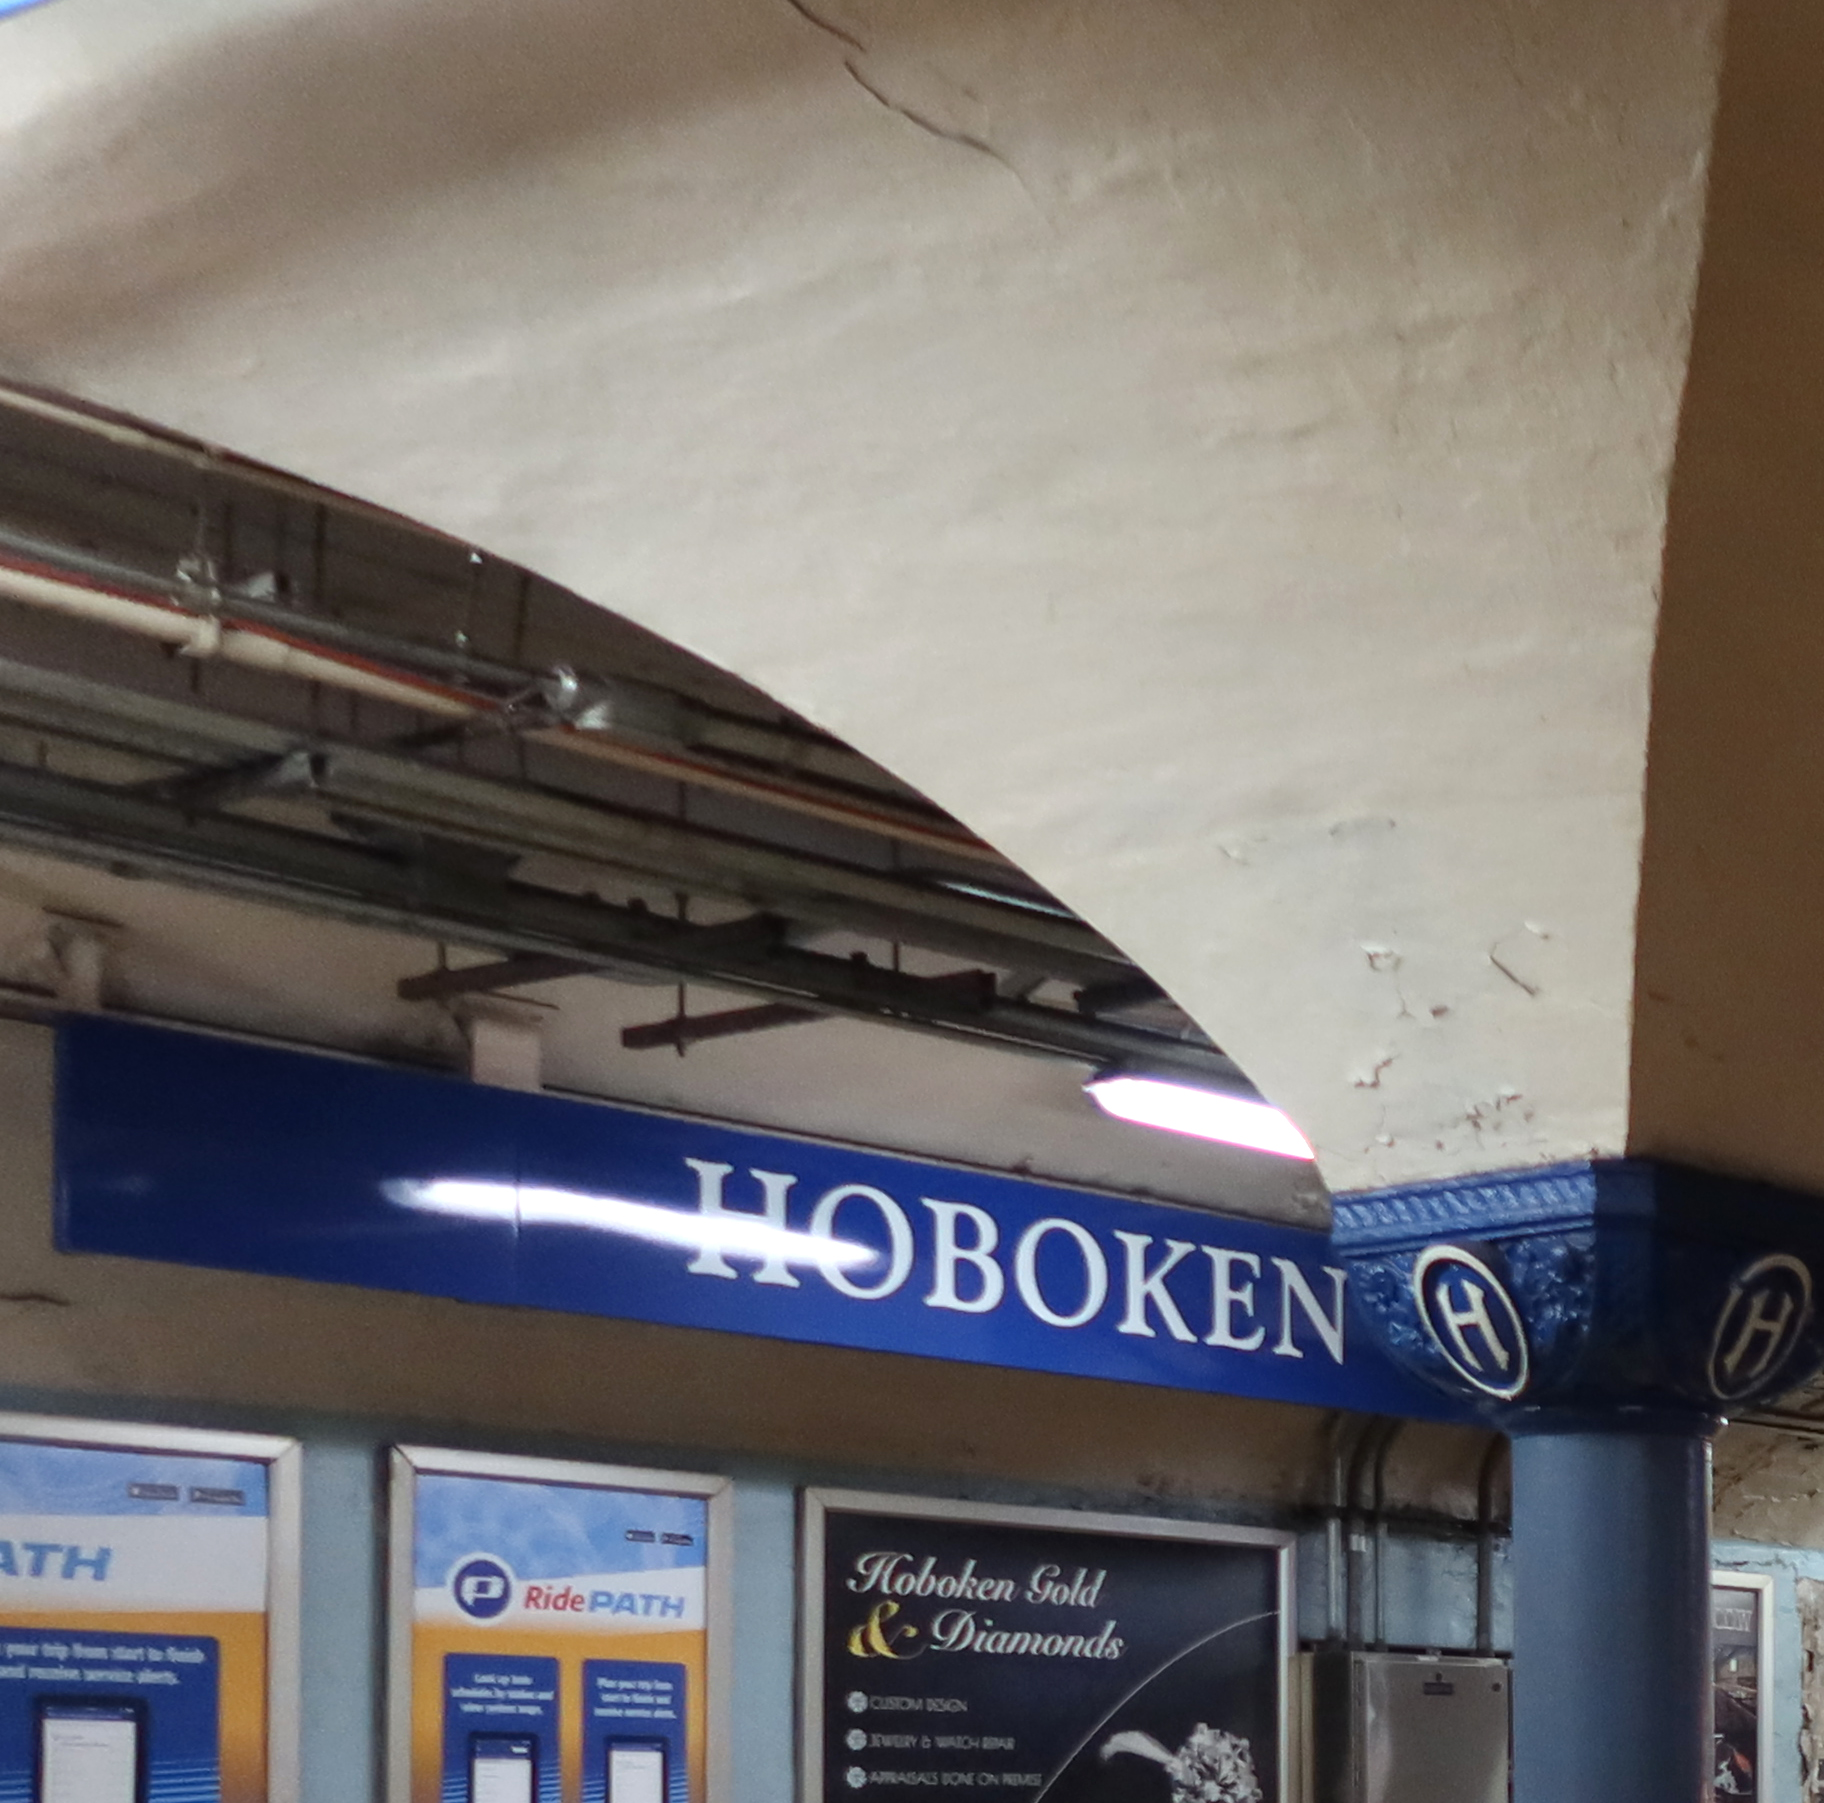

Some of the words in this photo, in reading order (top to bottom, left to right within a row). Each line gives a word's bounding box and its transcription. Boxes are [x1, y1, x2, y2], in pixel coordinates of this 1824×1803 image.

[684, 1157, 1346, 1365] HOBOKEN
[1436, 1279, 1509, 1371] H
[1724, 1290, 1793, 1378] H
[846, 1551, 1017, 1602] Hoboken
[1024, 1564, 1107, 1608] Gold
[848, 1600, 920, 1660] &
[930, 1608, 1125, 1660] Diamonds
